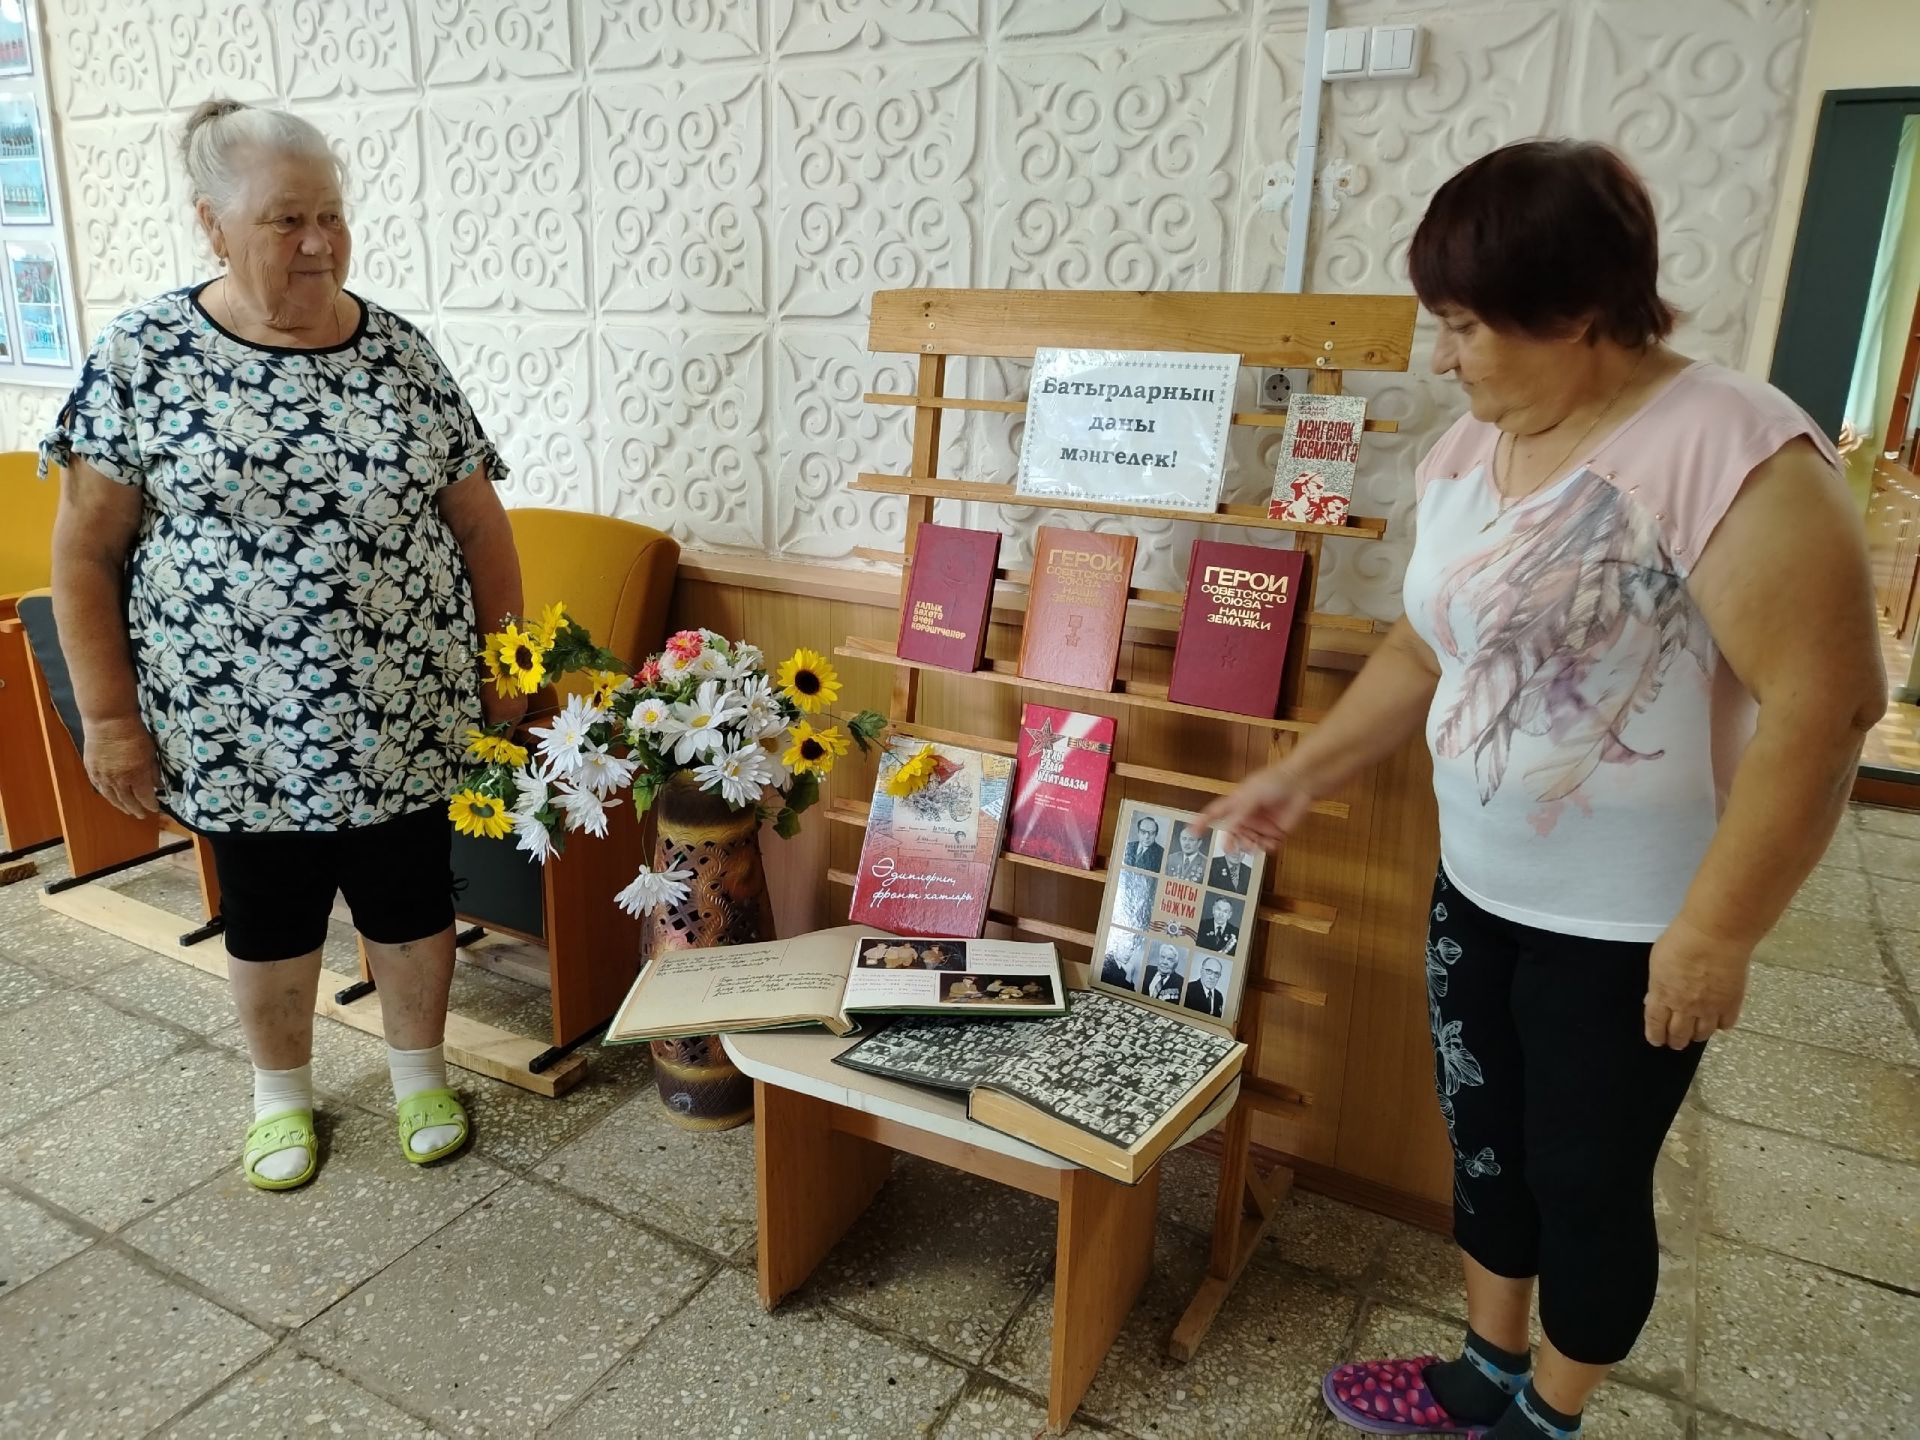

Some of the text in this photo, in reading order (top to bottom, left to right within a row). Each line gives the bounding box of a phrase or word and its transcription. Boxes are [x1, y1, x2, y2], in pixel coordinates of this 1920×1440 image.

[1042, 377, 1215, 404] Батырларның
[1088, 416, 1155, 433] даны
[1060, 447, 1178, 468] мәңгелек!
[1048, 549, 1125, 573] ГЕРОИ
[1046, 565, 1123, 583] СОВЕТСКОГО
[1204, 566, 1289, 594] ГЕРОИ
[1201, 584, 1287, 604] СОВЕТСКОГО
[1213, 595, 1261, 609] СОЮЗА
[915, 600, 943, 612] ХАЛЫК
[1219, 607, 1260, 620] НАШИ
[1207, 614, 1271, 630] ЗЕМЛЯКИ
[870, 887, 974, 908] фронт хатлары
[1165, 880, 1199, 902] СОҢГЫ
